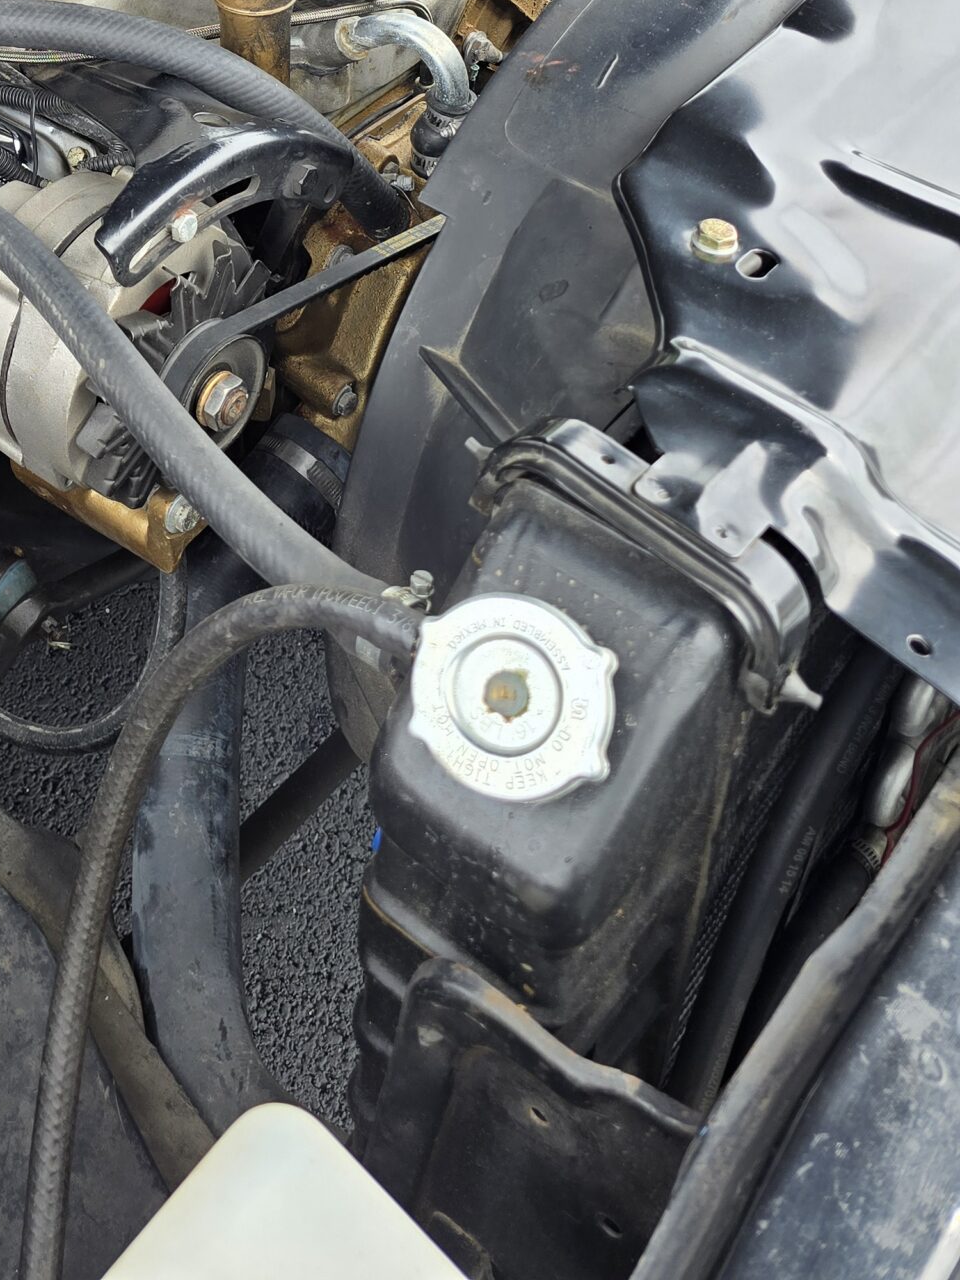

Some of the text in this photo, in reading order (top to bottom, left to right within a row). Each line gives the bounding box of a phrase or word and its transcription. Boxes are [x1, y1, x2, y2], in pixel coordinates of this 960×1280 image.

[492, 617, 507, 628] IN
[432, 704, 572, 774] DO NOT OPEN HOT
[447, 750, 549, 790] KEEP TIGHT
